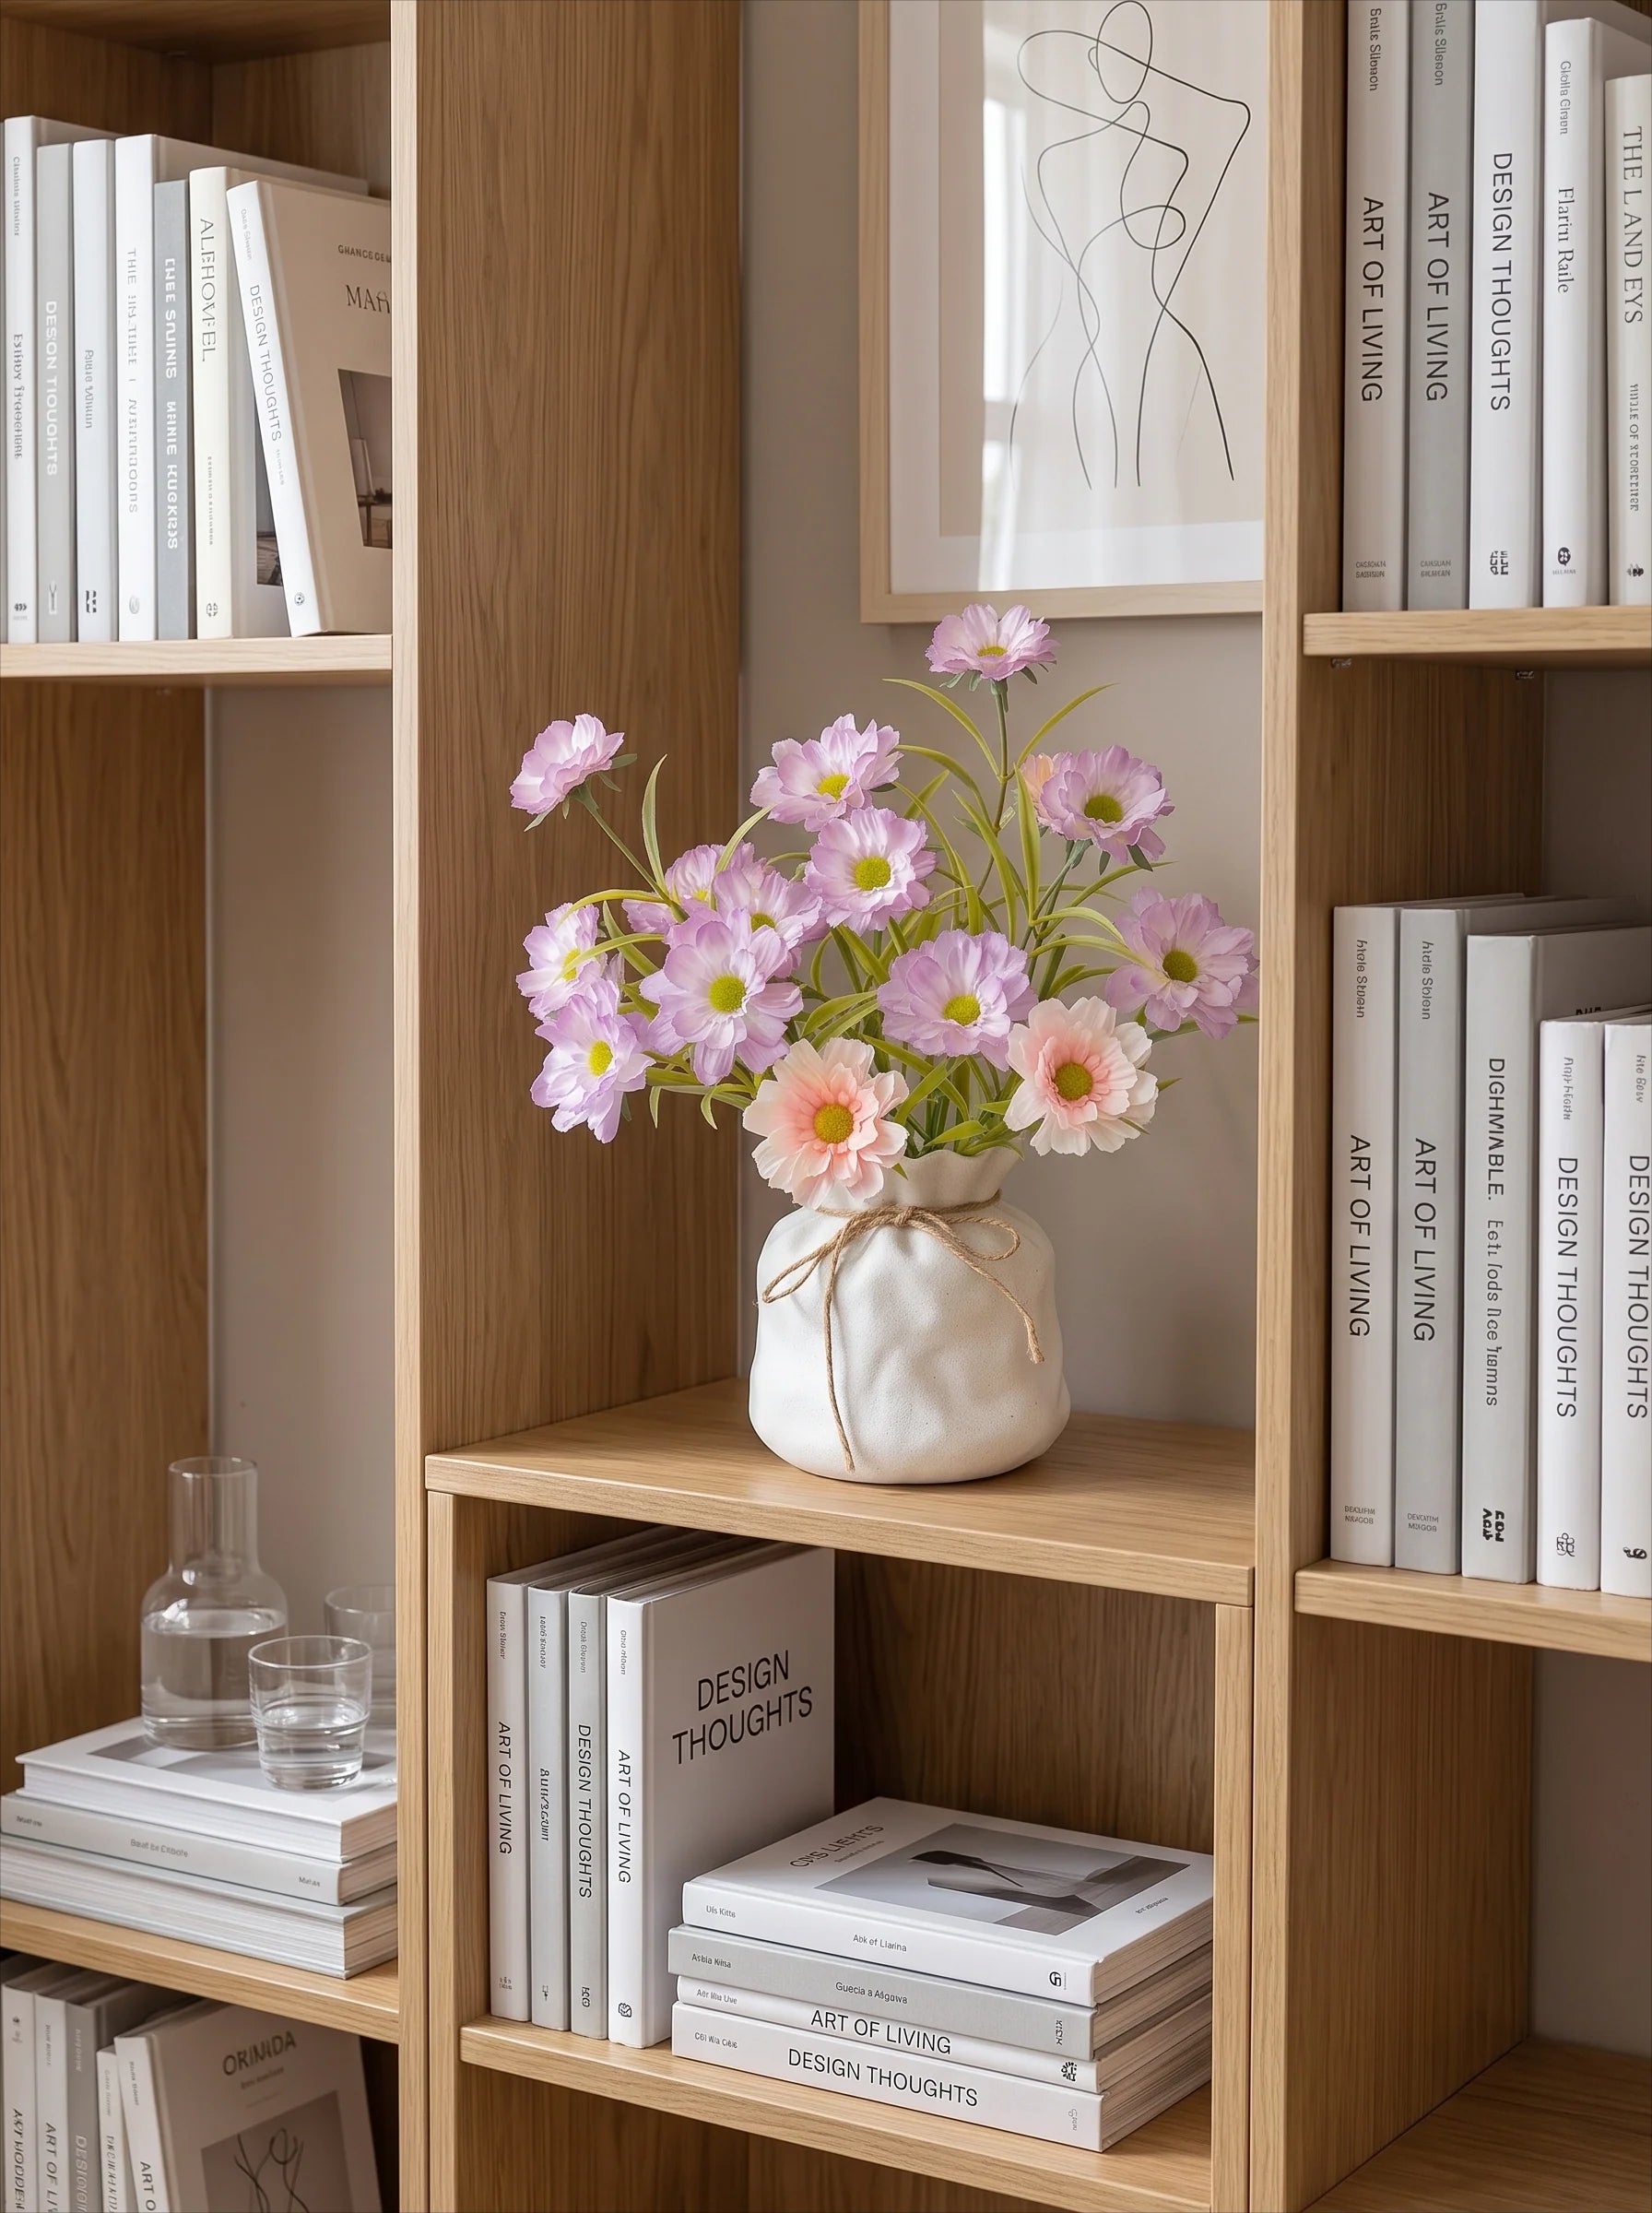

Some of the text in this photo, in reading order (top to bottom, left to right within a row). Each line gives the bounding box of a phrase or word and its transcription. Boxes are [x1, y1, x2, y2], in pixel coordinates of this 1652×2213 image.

[1623, 126, 1642, 181] THE
[1490, 152, 1513, 410] DESIGN THOUGHTS
[1557, 249, 1575, 293] Raile
[1624, 212, 1643, 268] AND
[1361, 196, 1385, 403] ART OF LIVING
[1425, 192, 1449, 402] ART OF LIVING
[1623, 278, 1643, 325] EYS
[249, 285, 266, 347] DESIGN
[259, 350, 282, 443] THOUGHTS
[1348, 1135, 1371, 1337] ART OF LIVING
[1413, 1138, 1436, 1342] ART OF LIVING
[1555, 1156, 1578, 1418] DESIGN THOUGHTS
[1626, 1154, 1650, 1419] DESIGN THOUGHTS
[672, 1686, 812, 1764] THOUGHTS
[698, 1650, 789, 1710] DESIGN
[498, 1722, 513, 1854] ART OF LIVING
[578, 1724, 592, 1899] DESIGN THOUGHTS
[618, 1749, 631, 1884] ART OF LIVING
[788, 2047, 979, 2108] DESIGN THOUGHTS
[810, 2008, 952, 2056] ART OF LIVING
[46, 2123, 56, 2156] ART
[47, 2161, 57, 2185] OF
[140, 2161, 154, 2194] ART
